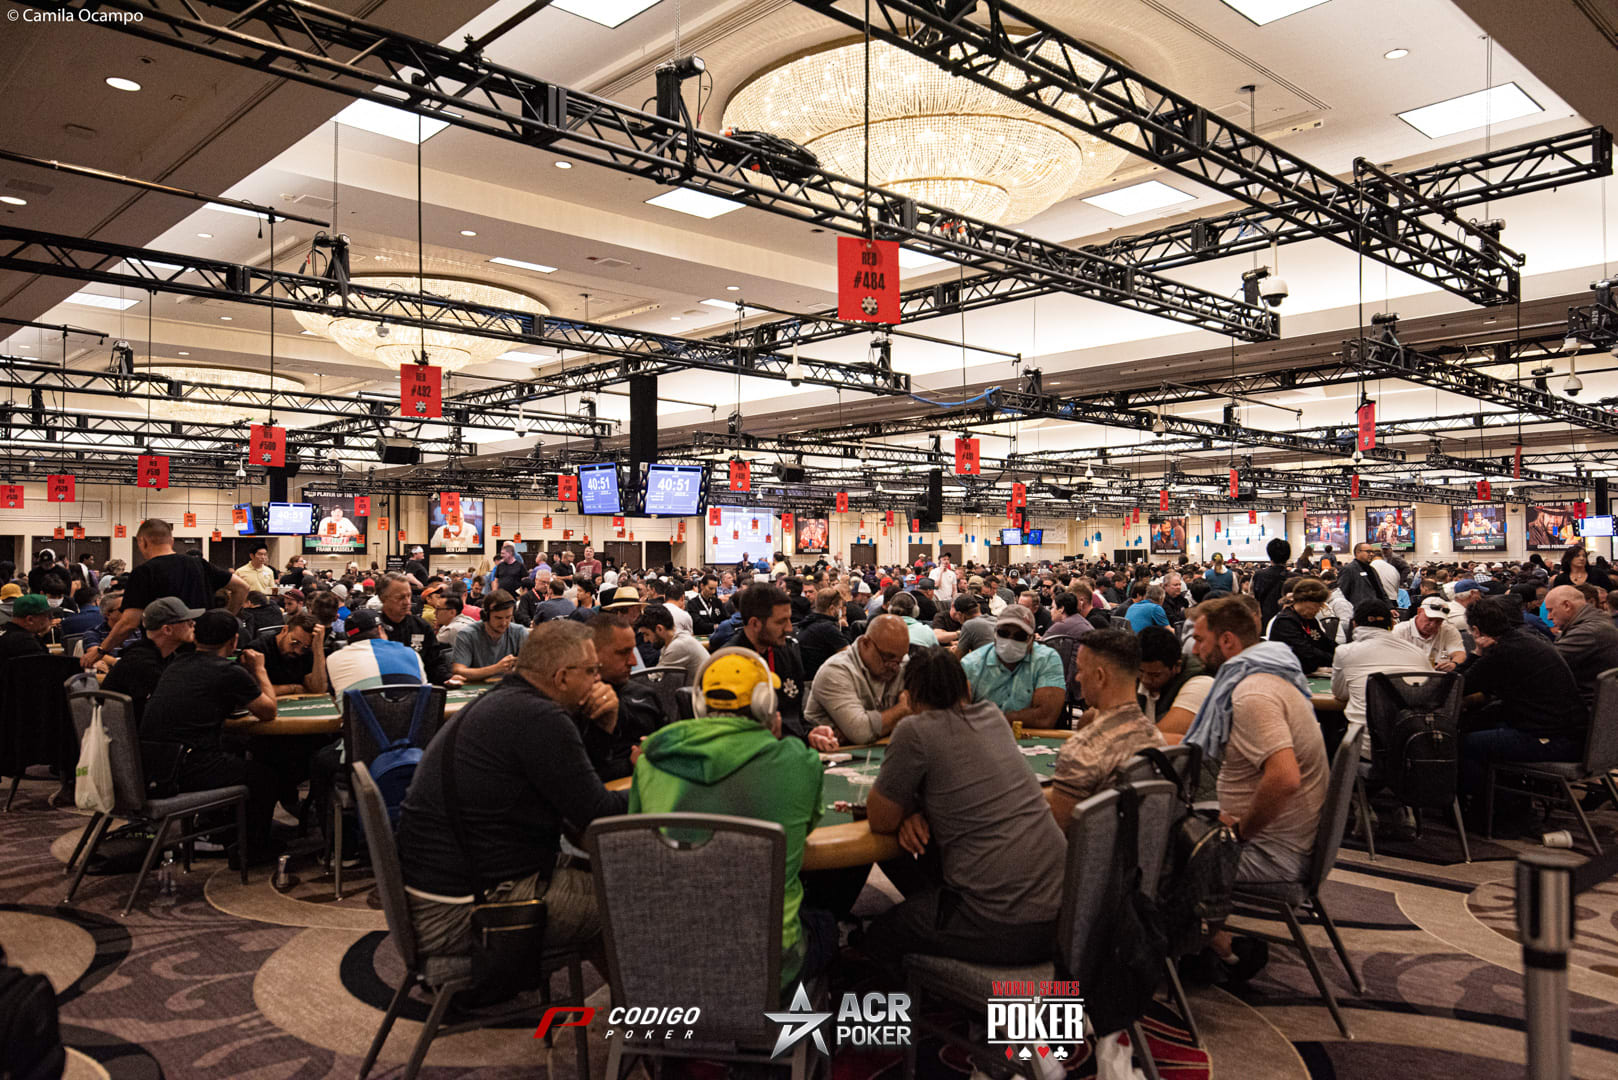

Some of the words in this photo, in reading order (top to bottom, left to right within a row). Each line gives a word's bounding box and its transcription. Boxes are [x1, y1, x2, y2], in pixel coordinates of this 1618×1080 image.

[862, 252, 877, 266] RED
[854, 271, 886, 290] #484
[587, 476, 610, 490] 40:51
[657, 477, 690, 491] 40:51
